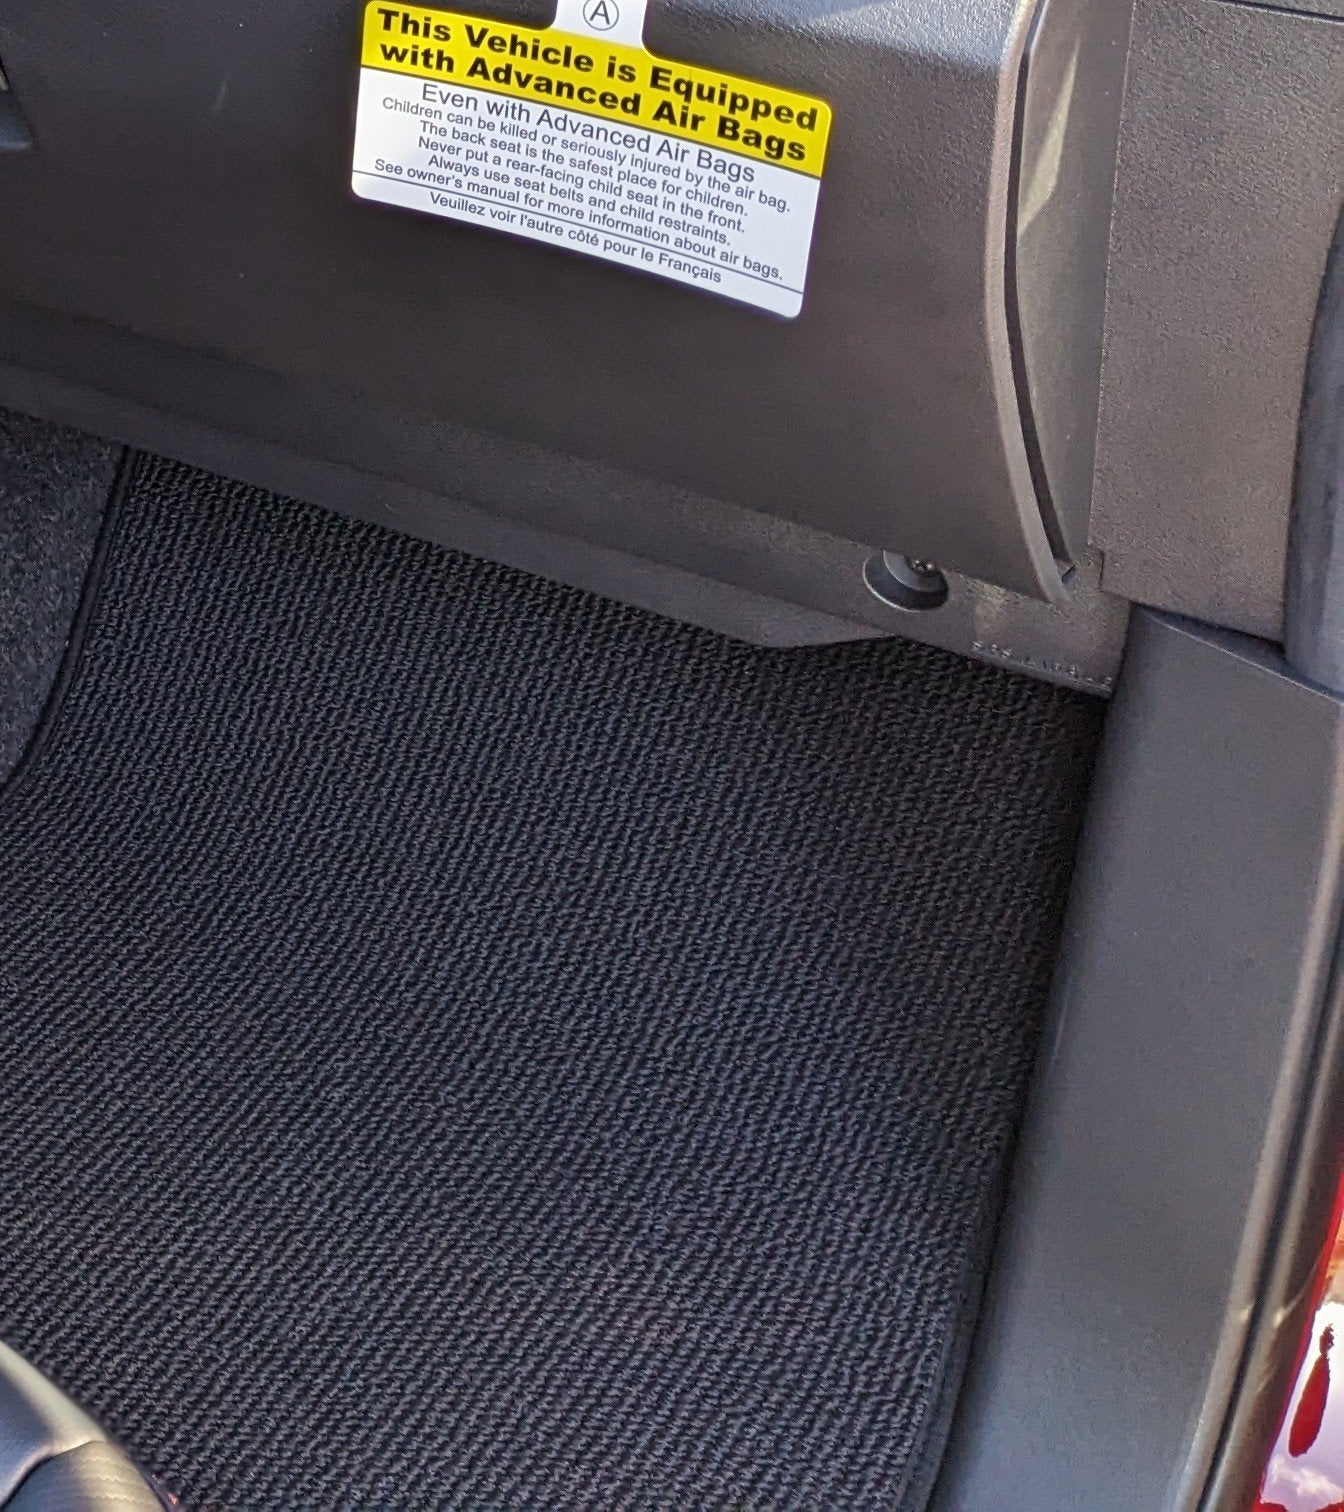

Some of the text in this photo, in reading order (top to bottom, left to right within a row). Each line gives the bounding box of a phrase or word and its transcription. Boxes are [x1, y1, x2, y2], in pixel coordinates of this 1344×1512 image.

[376, 7, 818, 132] This Vehicle is Equipped
[379, 43, 806, 162] with Advanced Air Bags
[382, 96, 791, 214] Children can be killed or seriously injured by the air bag.
[419, 119, 748, 217] The back seat is the safest place for children.
[422, 82, 755, 184] Even with Advanced Air Bags
[374, 158, 404, 176] See
[466, 181, 521, 204] manual
[523, 192, 545, 209] for
[547, 201, 585, 220] more
[588, 209, 670, 245] information
[673, 236, 717, 259] about
[719, 250, 740, 265] air
[742, 254, 783, 281] bags.
[418, 135, 745, 234] Never put a rear-facing child seat in the front.
[427, 154, 731, 247] Always use seat belts and child restraints.
[429, 190, 486, 217] Veuillez
[489, 208, 517, 224] voir
[567, 229, 600, 247] côté
[602, 239, 638, 257] pour
[640, 246, 654, 263] le
[658, 252, 722, 283] Français
